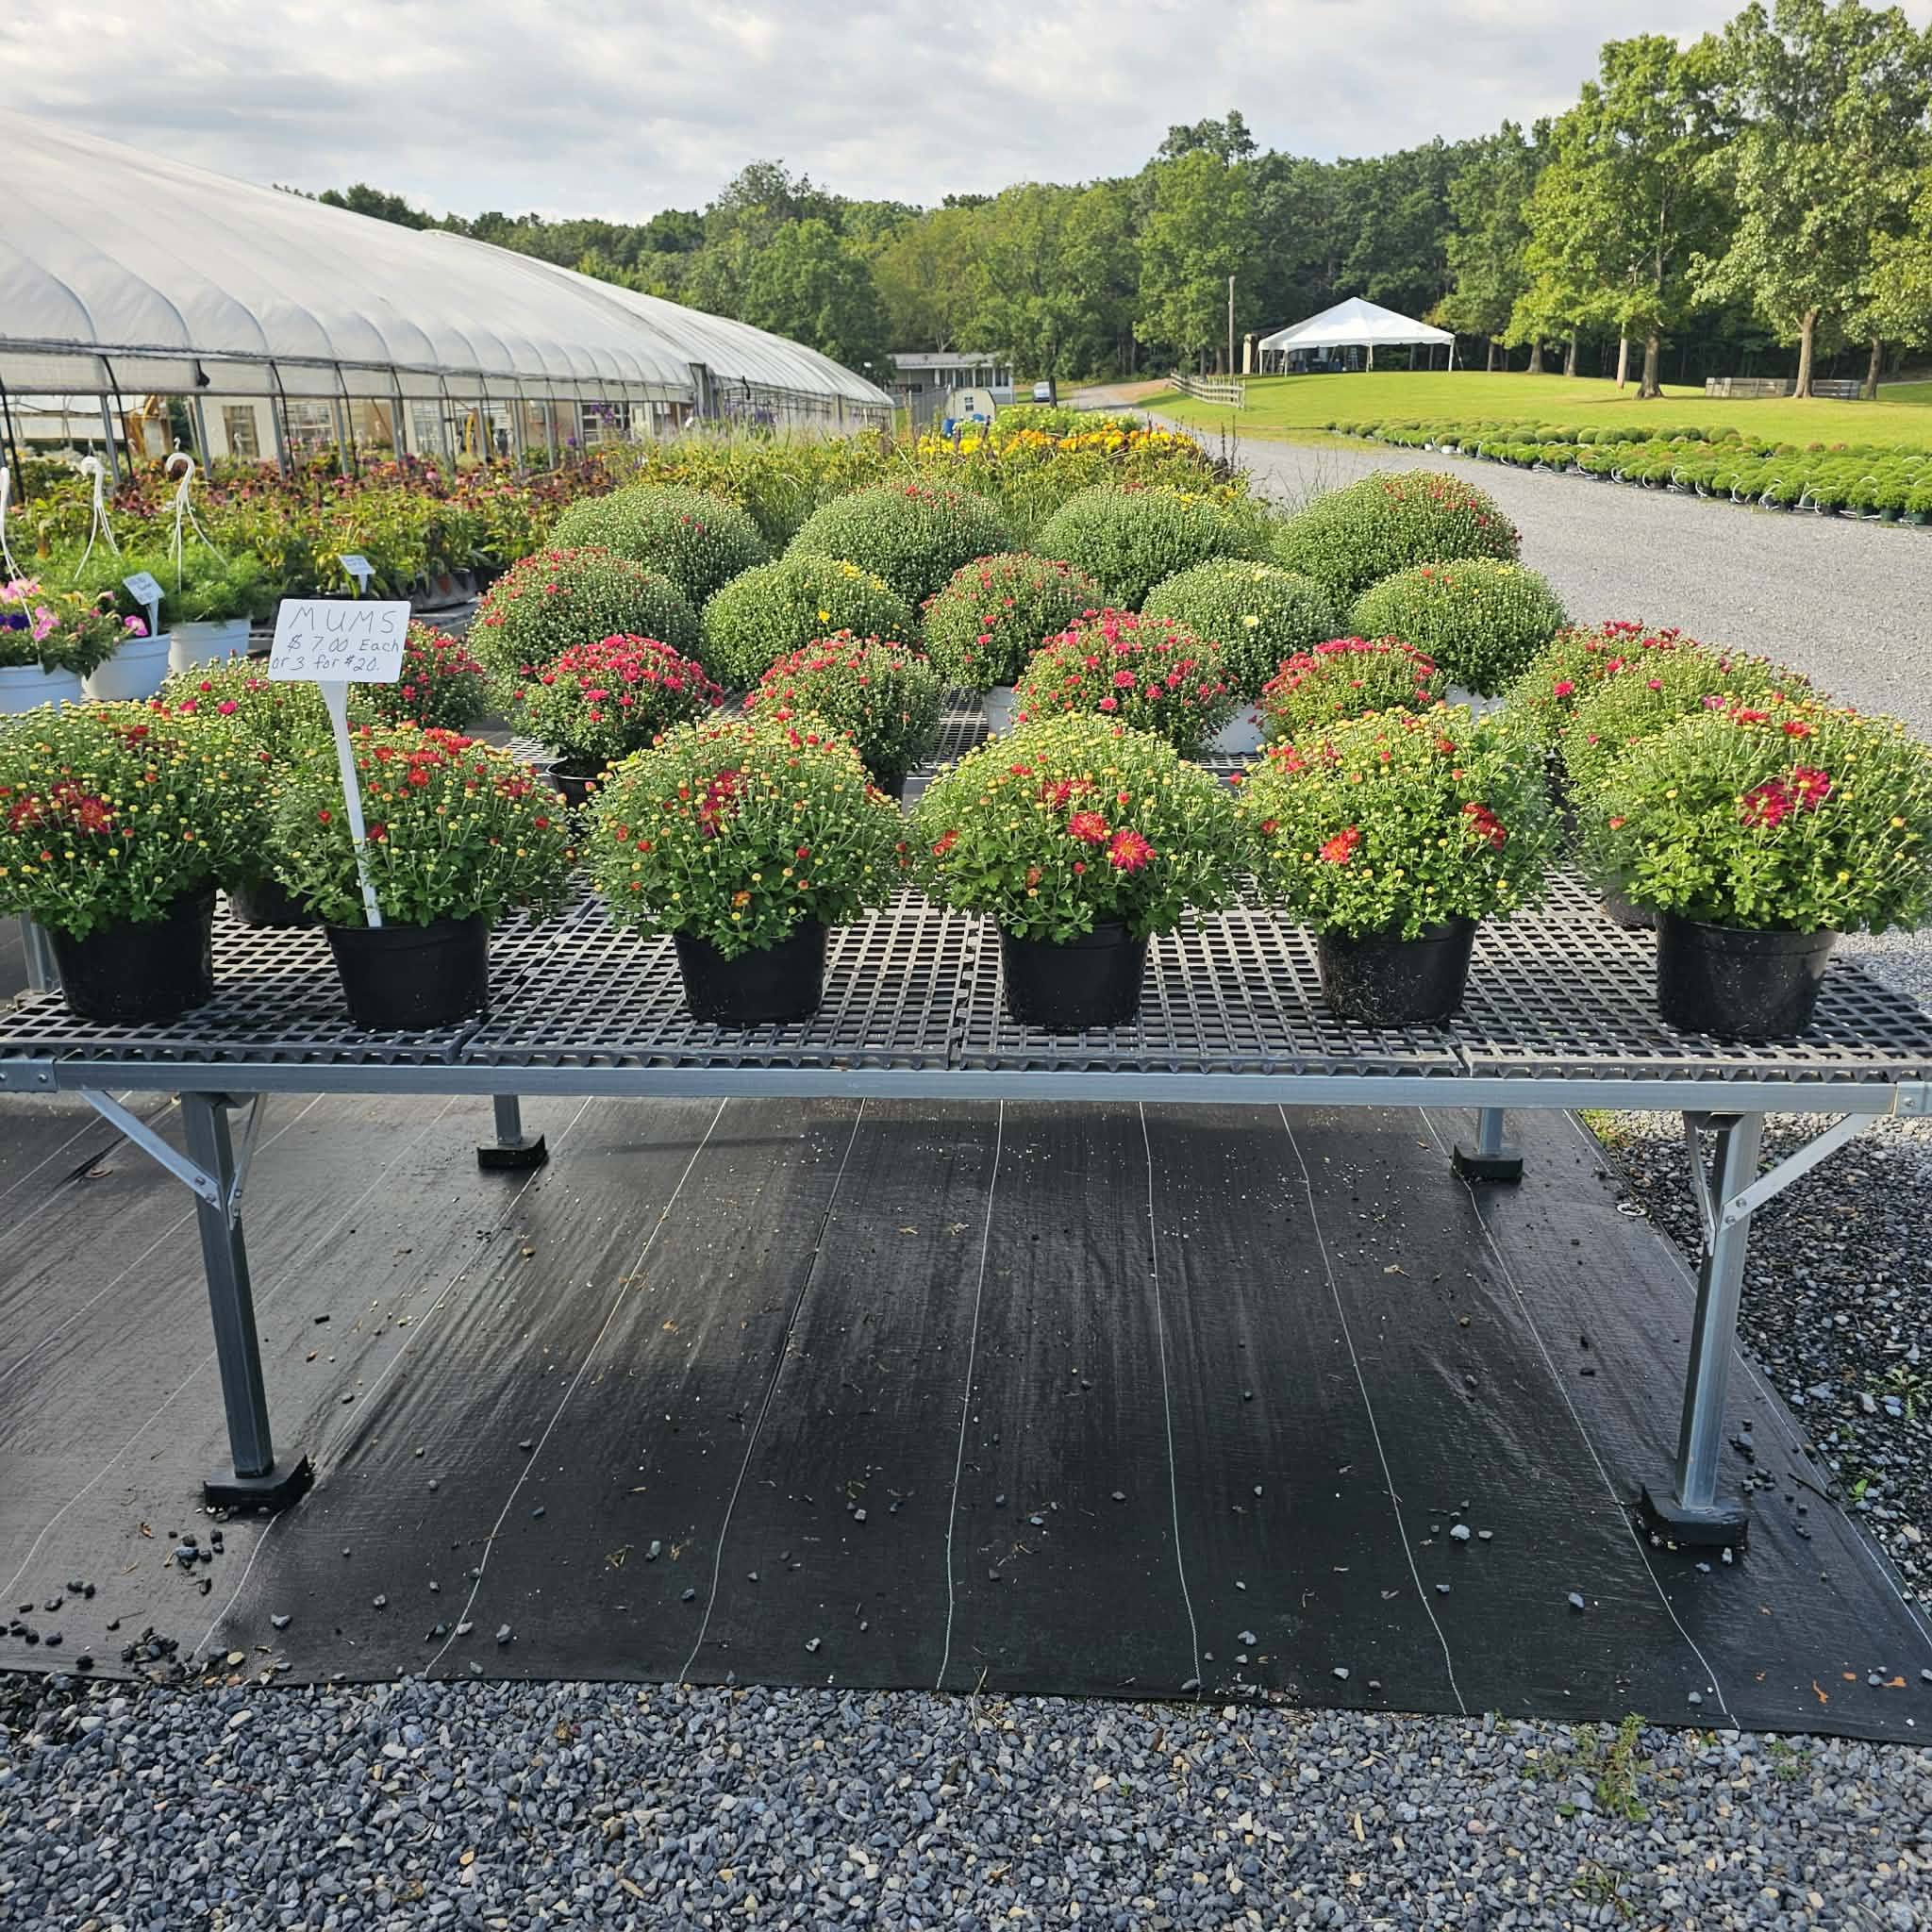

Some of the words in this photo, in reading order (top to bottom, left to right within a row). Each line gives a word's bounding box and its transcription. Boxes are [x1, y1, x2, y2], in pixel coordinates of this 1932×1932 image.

[289, 606, 397, 633] MUMS
[358, 639, 399, 652] Each
[272, 657, 290, 670] or
[289, 656, 305, 671] 3
[313, 654, 340, 670] for
